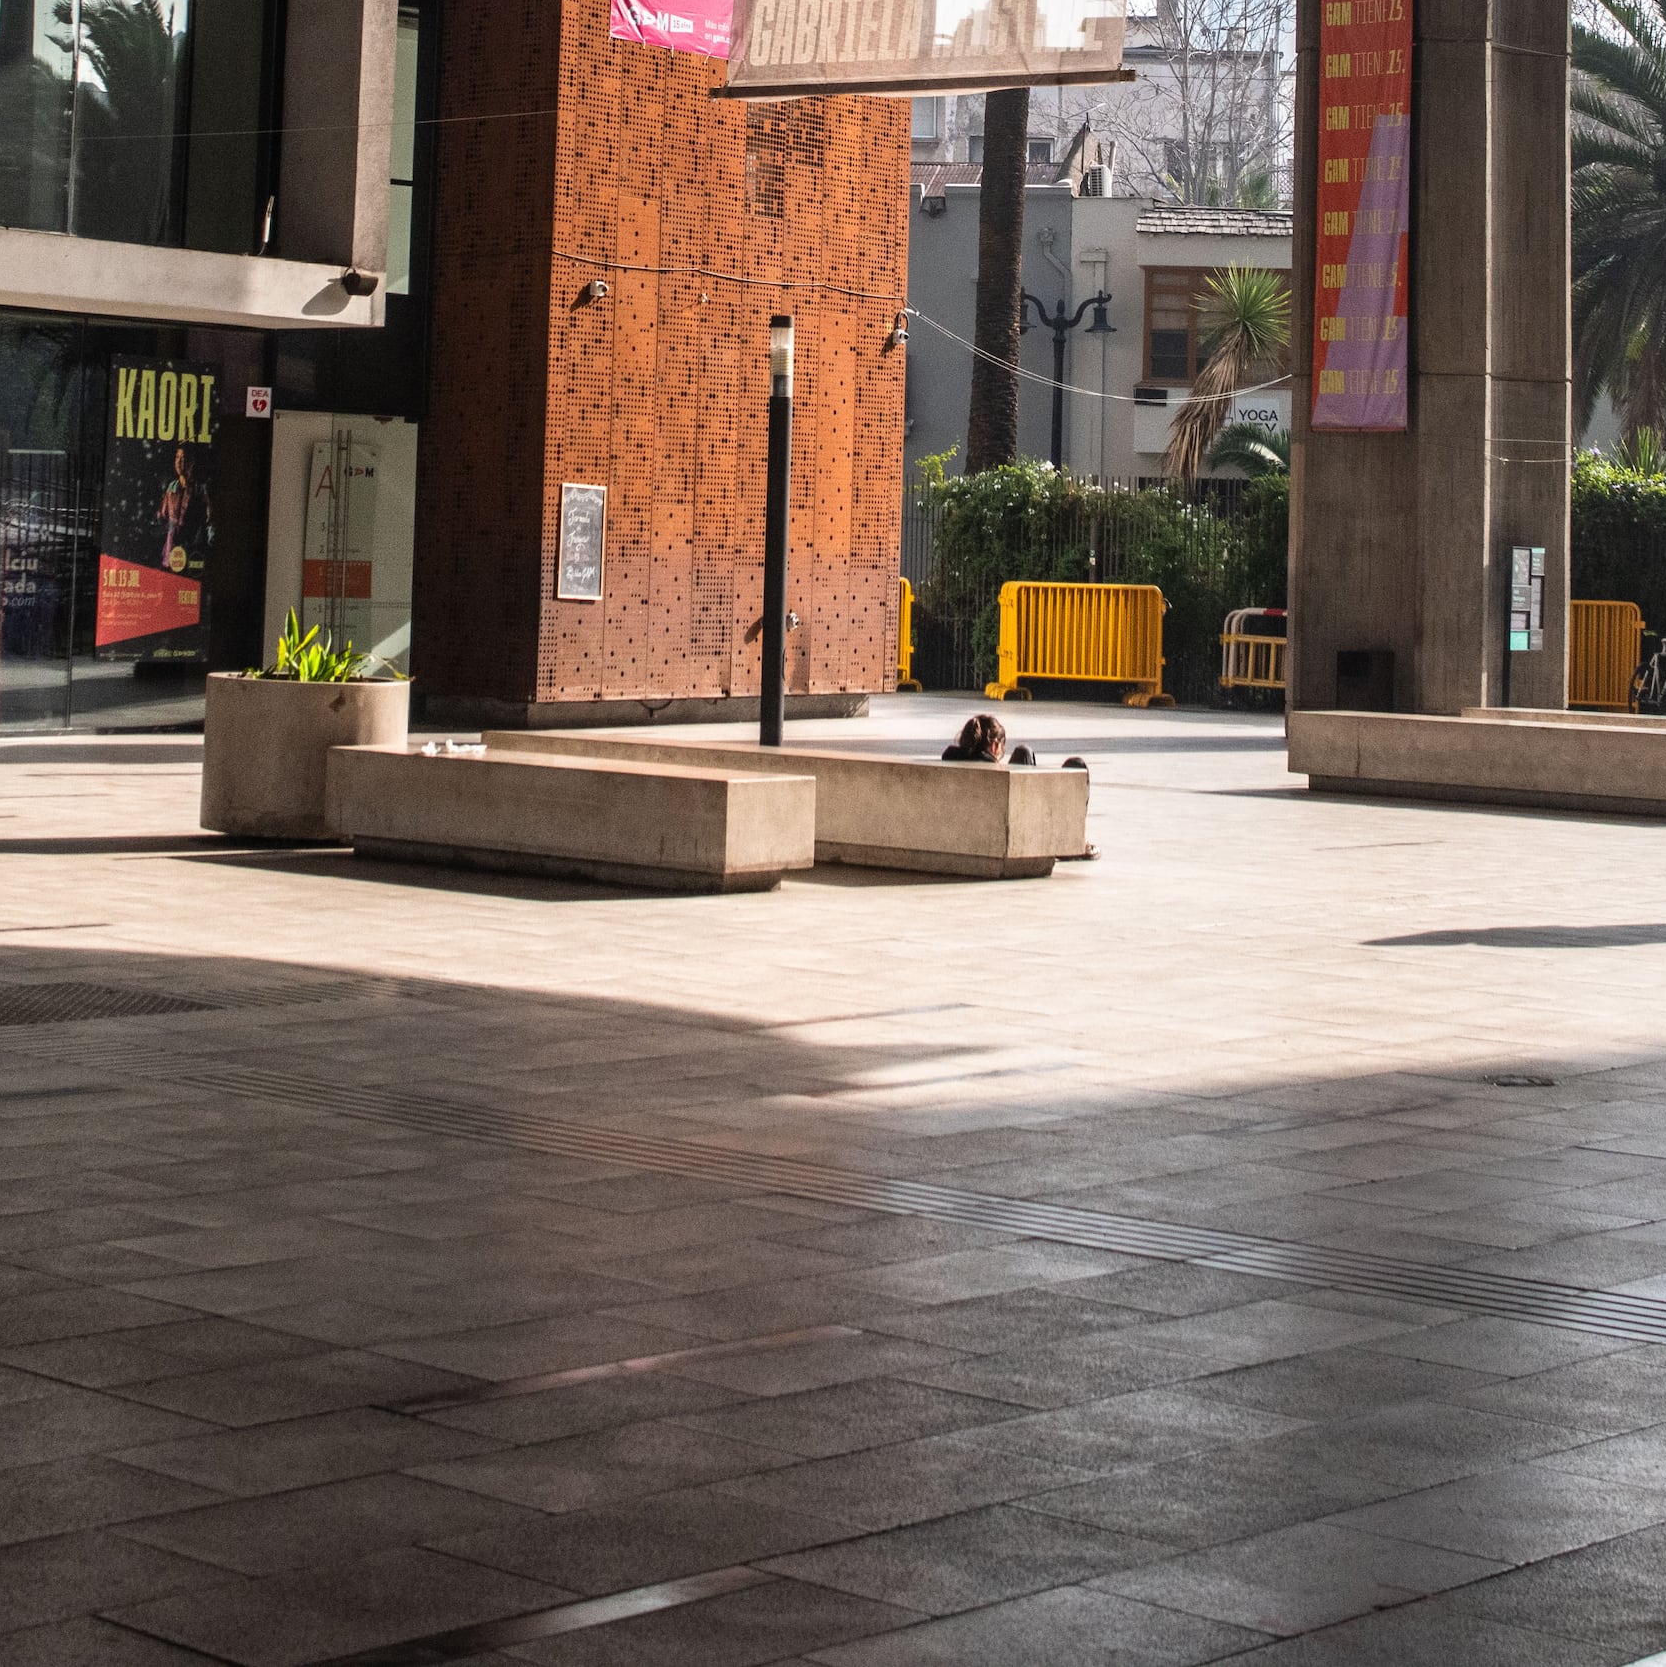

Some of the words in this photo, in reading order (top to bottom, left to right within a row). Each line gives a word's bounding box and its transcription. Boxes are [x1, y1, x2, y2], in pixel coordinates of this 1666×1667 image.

[672, 19, 680, 29] 15
[1326, 1, 1351, 26] GAM
[717, 22, 730, 32] info
[1326, 54, 1351, 78] GAM
[1354, 51, 1383, 77] TIEN
[1386, 50, 1406, 74] 15.
[1326, 106, 1349, 130] GAM
[1324, 158, 1348, 183] GAM
[1324, 211, 1348, 235] GAM
[1323, 264, 1347, 288] GAM
[1320, 317, 1346, 342] GAM
[1350, 316, 1378, 341] TIEN
[251, 389, 269, 398] DEA
[1320, 370, 1345, 394] GAM
[116, 367, 215, 444] KAORI
[1238, 409, 1279, 421] YOGA
[102, 569, 108, 587] 5
[108, 569, 118, 587] AL
[118, 569, 127, 587] 13
[128, 570, 140, 587] JUL
[178, 590, 198, 605] TEATRO
